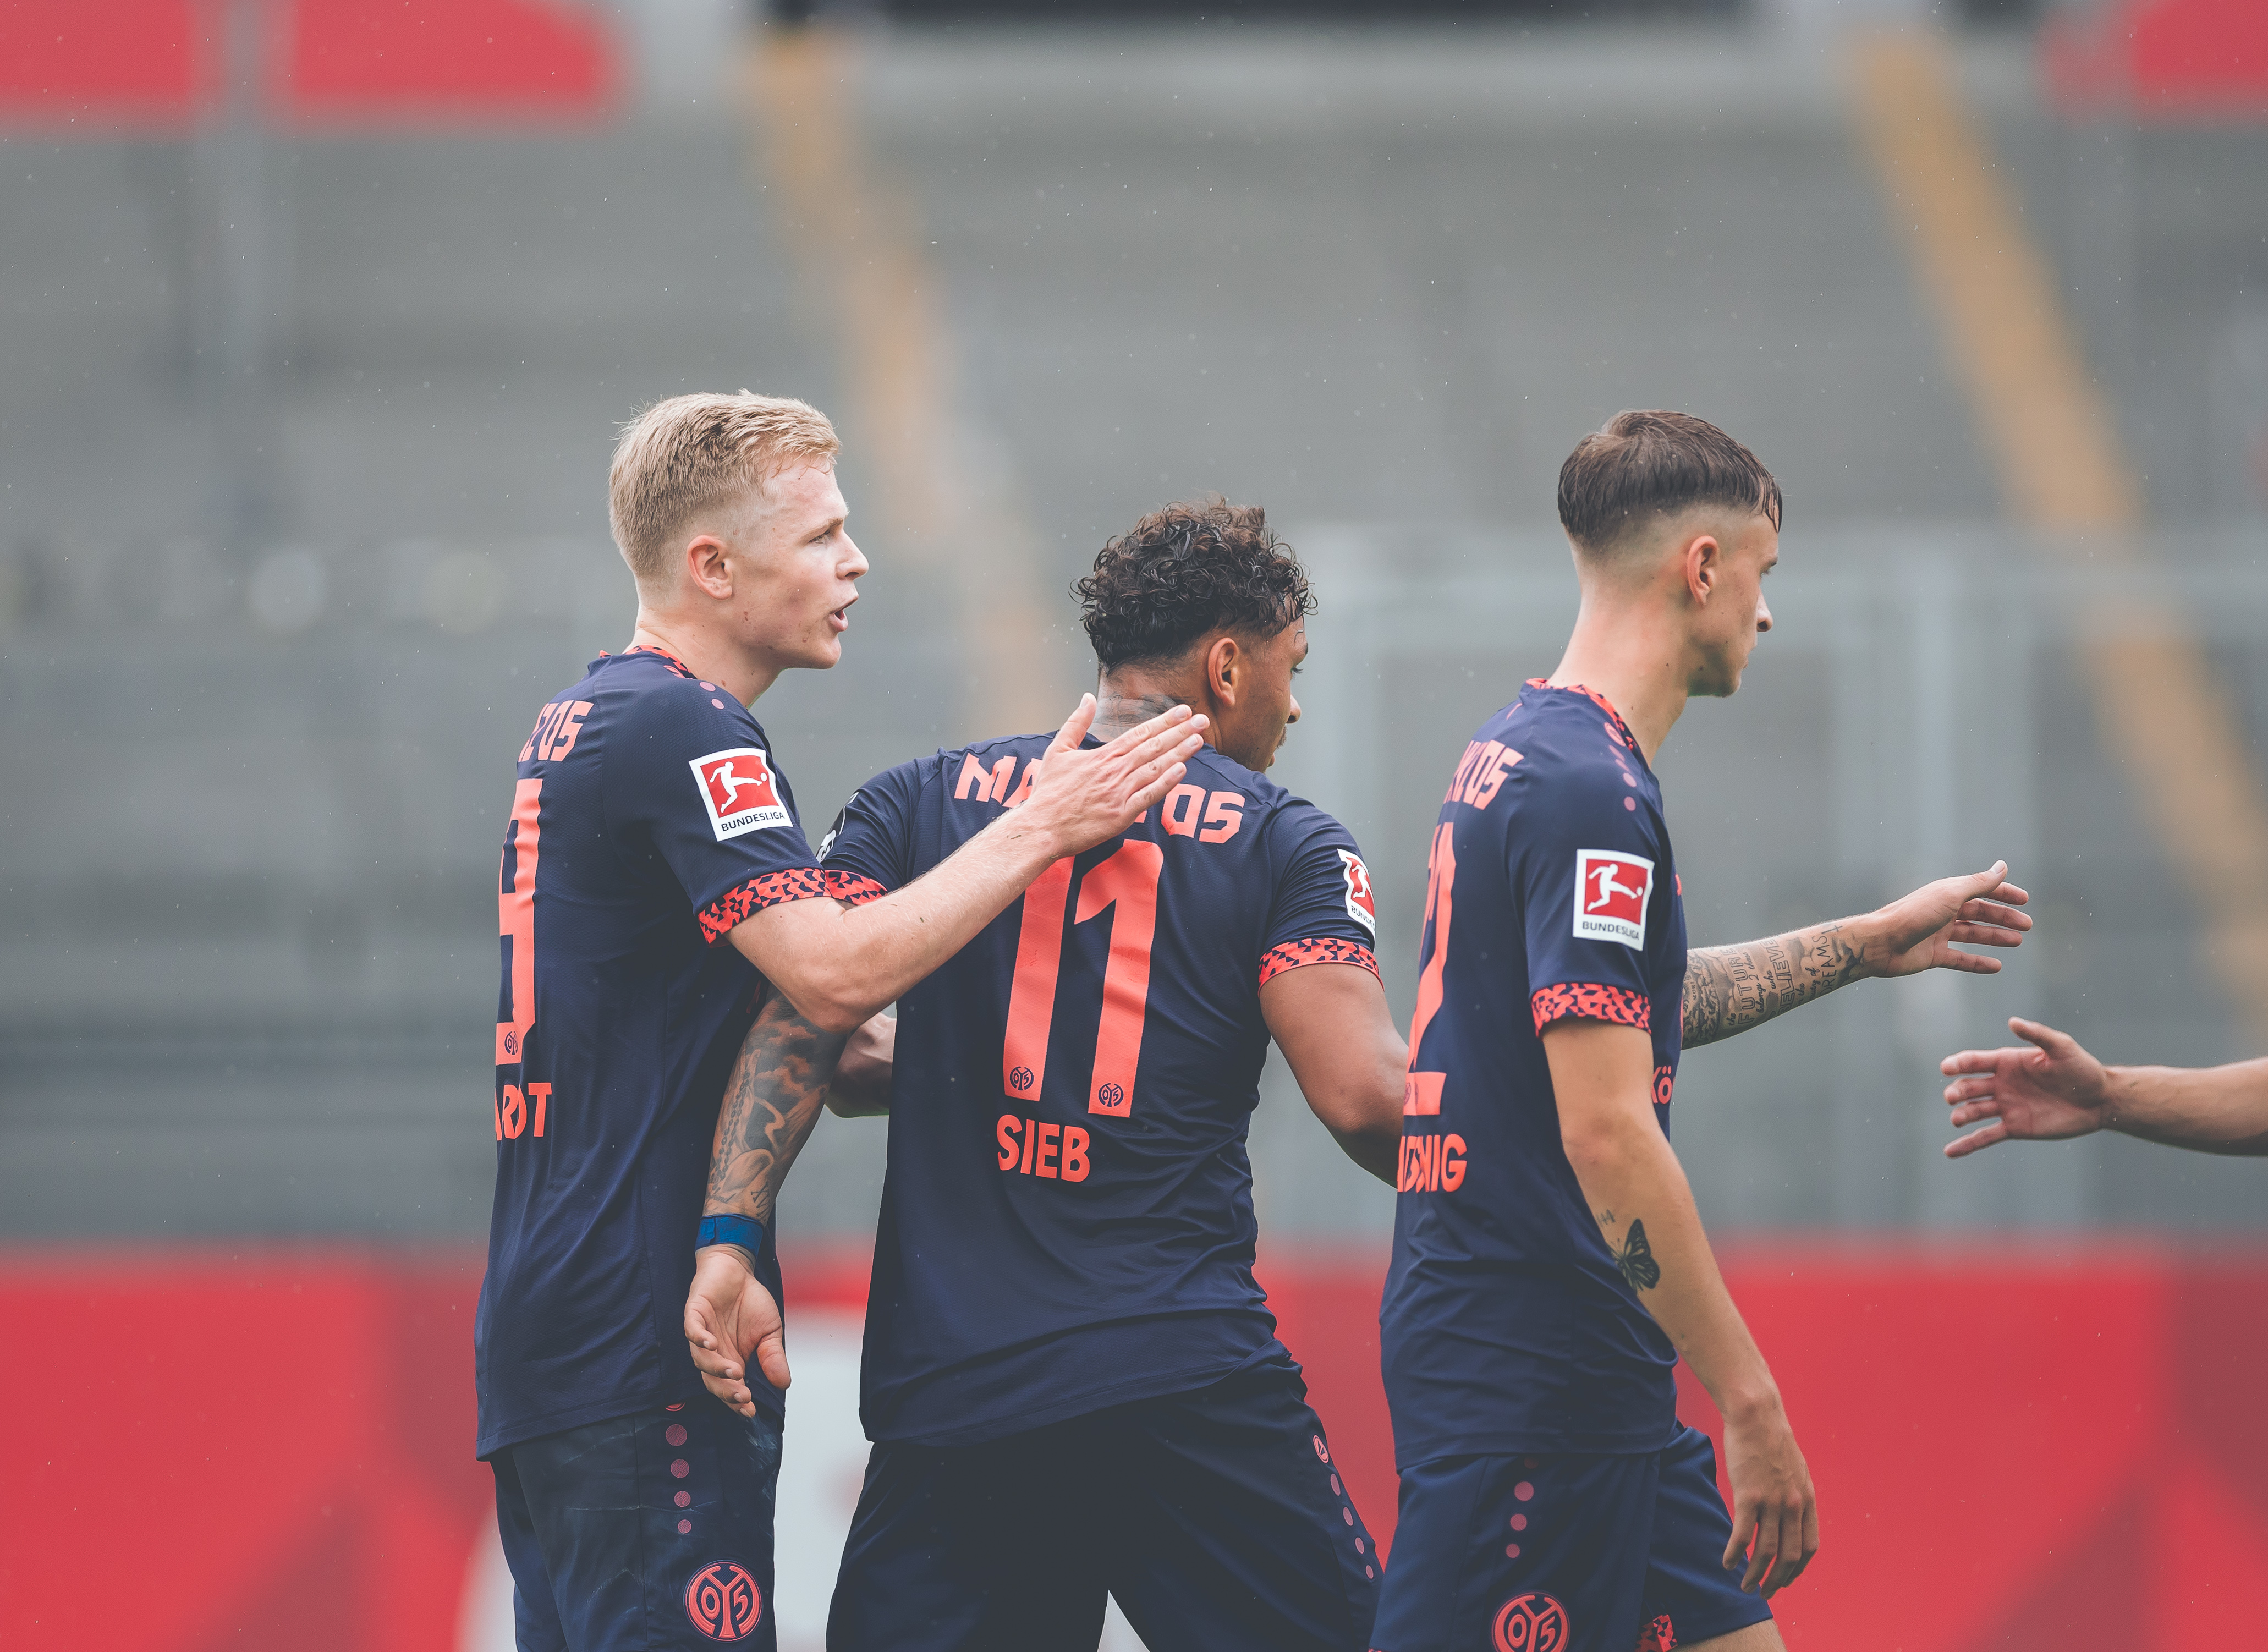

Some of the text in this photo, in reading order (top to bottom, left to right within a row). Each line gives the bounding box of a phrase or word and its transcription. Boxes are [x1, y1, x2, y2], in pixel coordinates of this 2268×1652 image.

[721, 811, 785, 831] BUNDESLIGA
[1582, 921, 1639, 940] BUNDESLIGA
[1003, 838, 1164, 1117] 11
[1721, 947, 1756, 1024] FUTURE
[1755, 983, 1767, 1013] belongs
[1760, 938, 1796, 1016] BELIEVE
[996, 1114, 1090, 1183] SIEB
